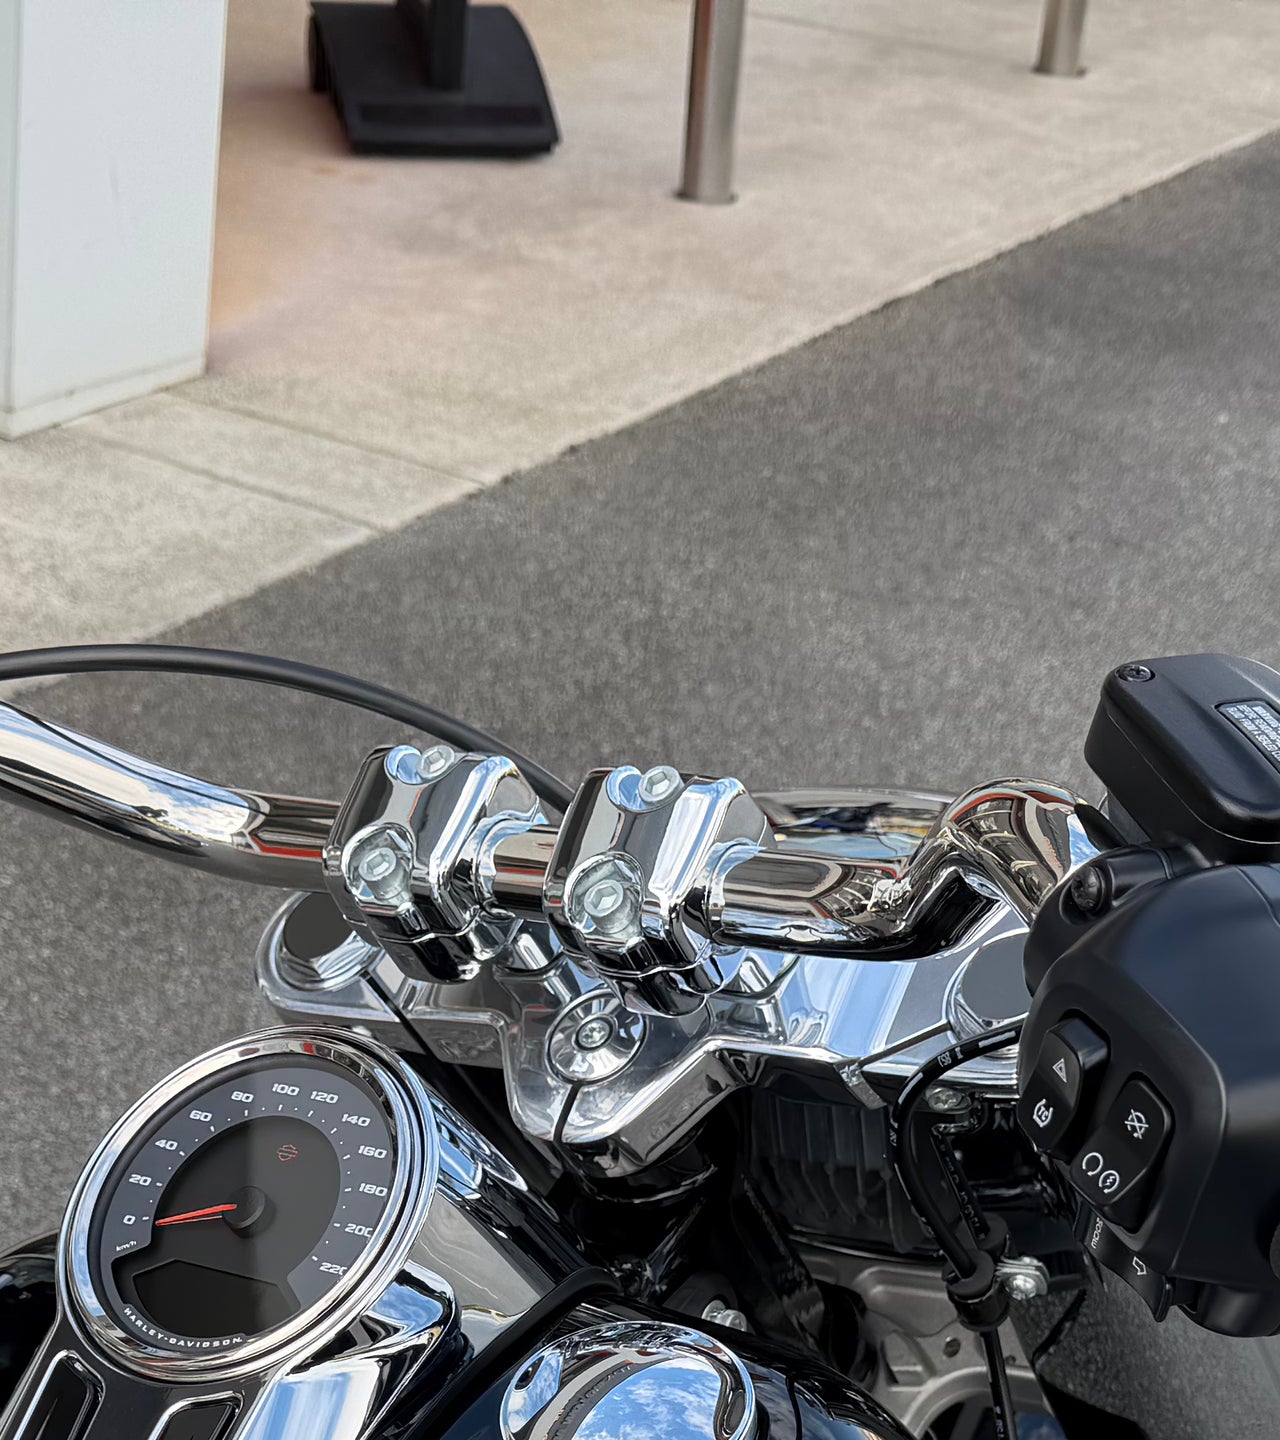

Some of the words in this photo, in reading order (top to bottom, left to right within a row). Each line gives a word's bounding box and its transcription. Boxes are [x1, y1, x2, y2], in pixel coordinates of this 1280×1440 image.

[271, 1083, 300, 1096] 100
[231, 1091, 254, 1103] 80
[310, 1090, 338, 1104] 120
[189, 1110, 212, 1122] 60
[341, 1113, 371, 1127] 140
[155, 1139, 178, 1151] 40
[358, 1145, 387, 1159] 160
[128, 1174, 152, 1187] 20
[359, 1182, 388, 1197] 180
[123, 1214, 136, 1225] 0
[123, 1306, 243, 1348] HARLEY-DAVIDSON
